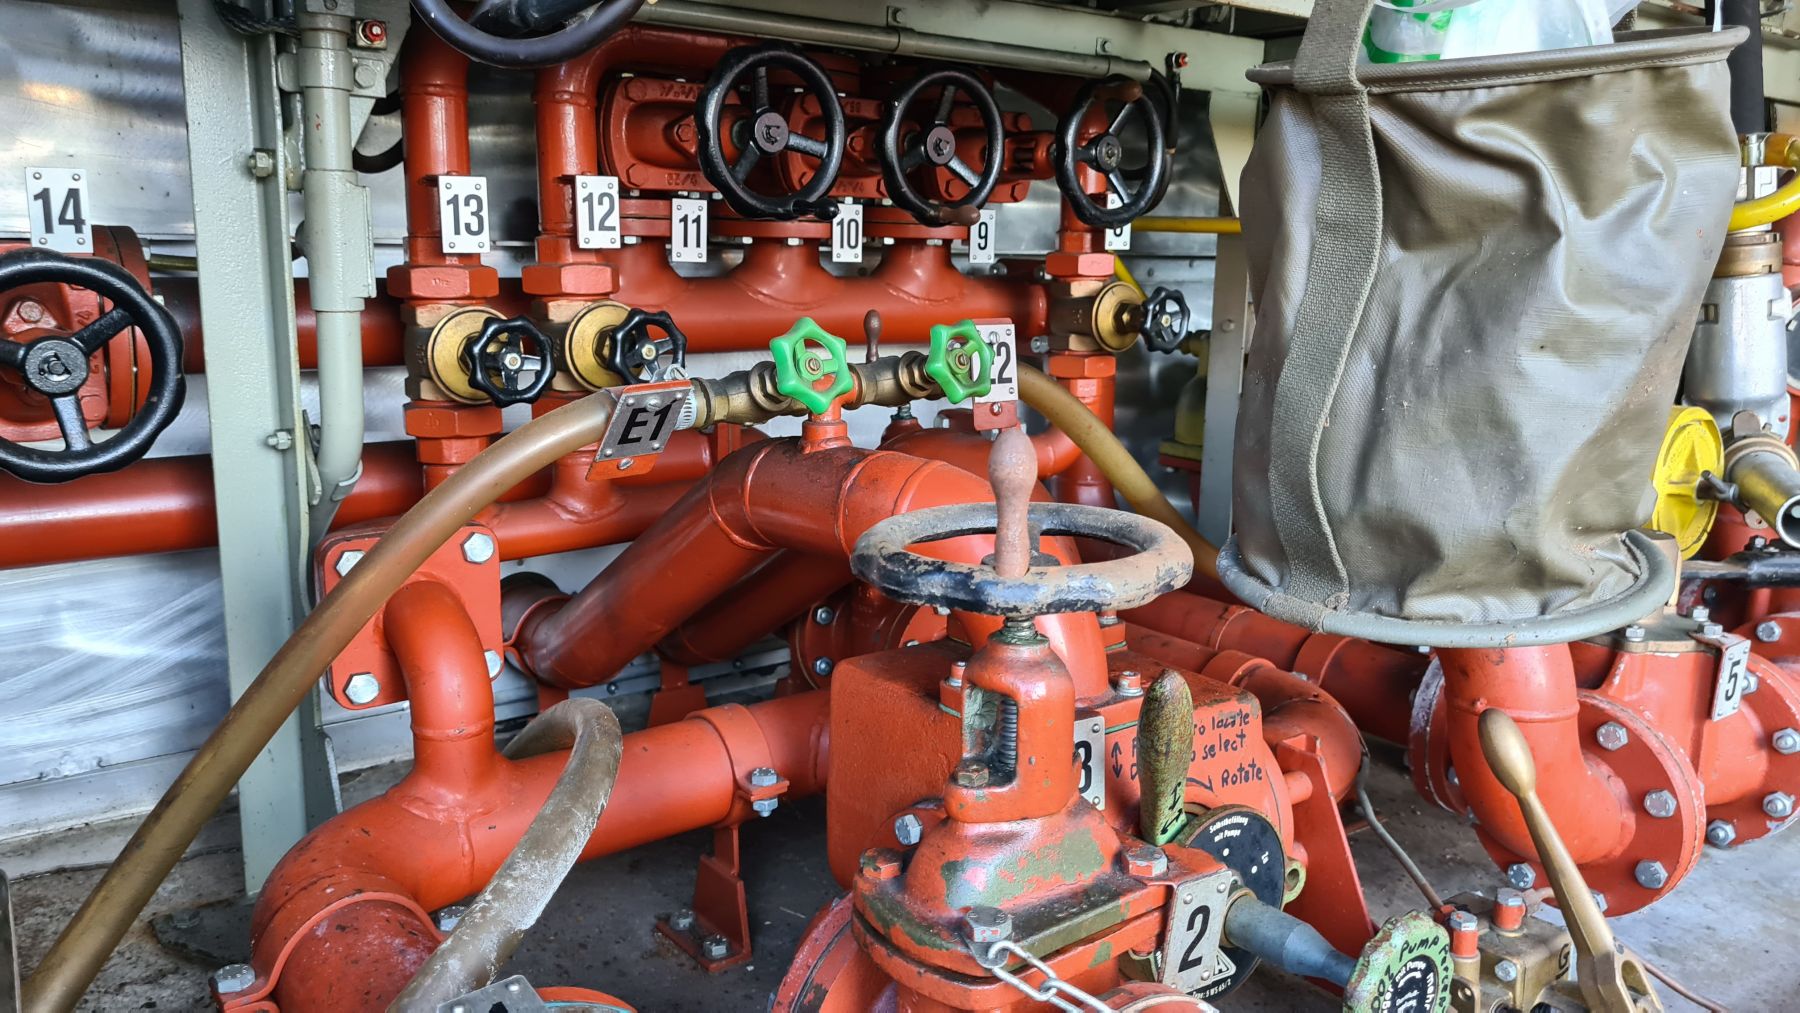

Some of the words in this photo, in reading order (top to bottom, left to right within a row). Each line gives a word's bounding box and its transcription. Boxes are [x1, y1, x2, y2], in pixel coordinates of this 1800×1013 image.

[33, 187, 86, 234] 14
[446, 194, 485, 236] 13
[582, 192, 617, 232] 12
[678, 213, 702, 248] 11
[836, 217, 860, 249] 10
[977, 221, 989, 251] 9
[989, 341, 1013, 385] 2
[617, 399, 677, 446] E1
[1725, 659, 1741, 702] 5
[1211, 708, 1250, 731] locate
[1202, 729, 1247, 761] select
[1221, 758, 1263, 788] Rotate
[1178, 904, 1211, 974] 2
[1424, 971, 1434, 1011] mehr
